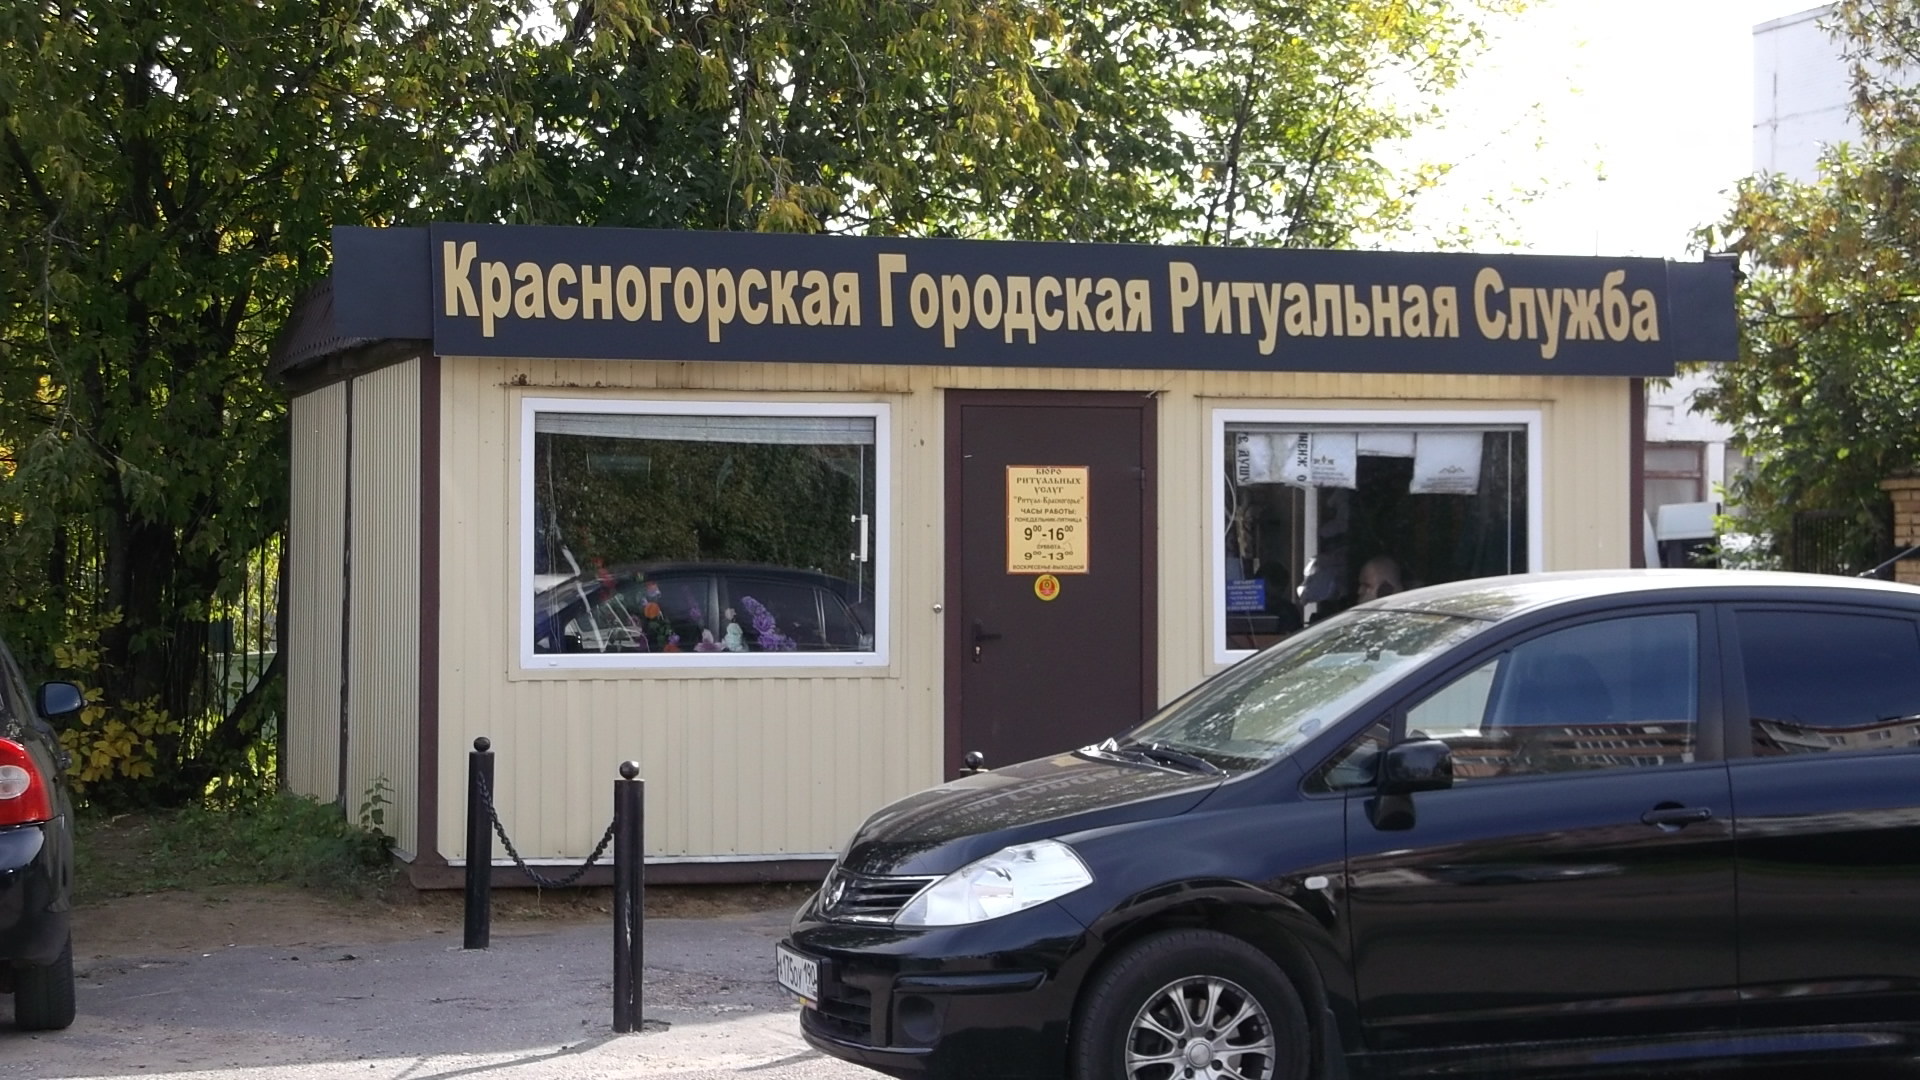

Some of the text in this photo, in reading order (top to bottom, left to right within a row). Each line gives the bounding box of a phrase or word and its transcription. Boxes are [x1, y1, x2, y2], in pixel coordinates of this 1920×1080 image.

[442, 241, 1660, 360] Красногорская Городская Ритуальная Служба
[1016, 477, 1081, 485] РИТУАЛЬНЫХ
[1034, 486, 1064, 495] УСЛУГ
